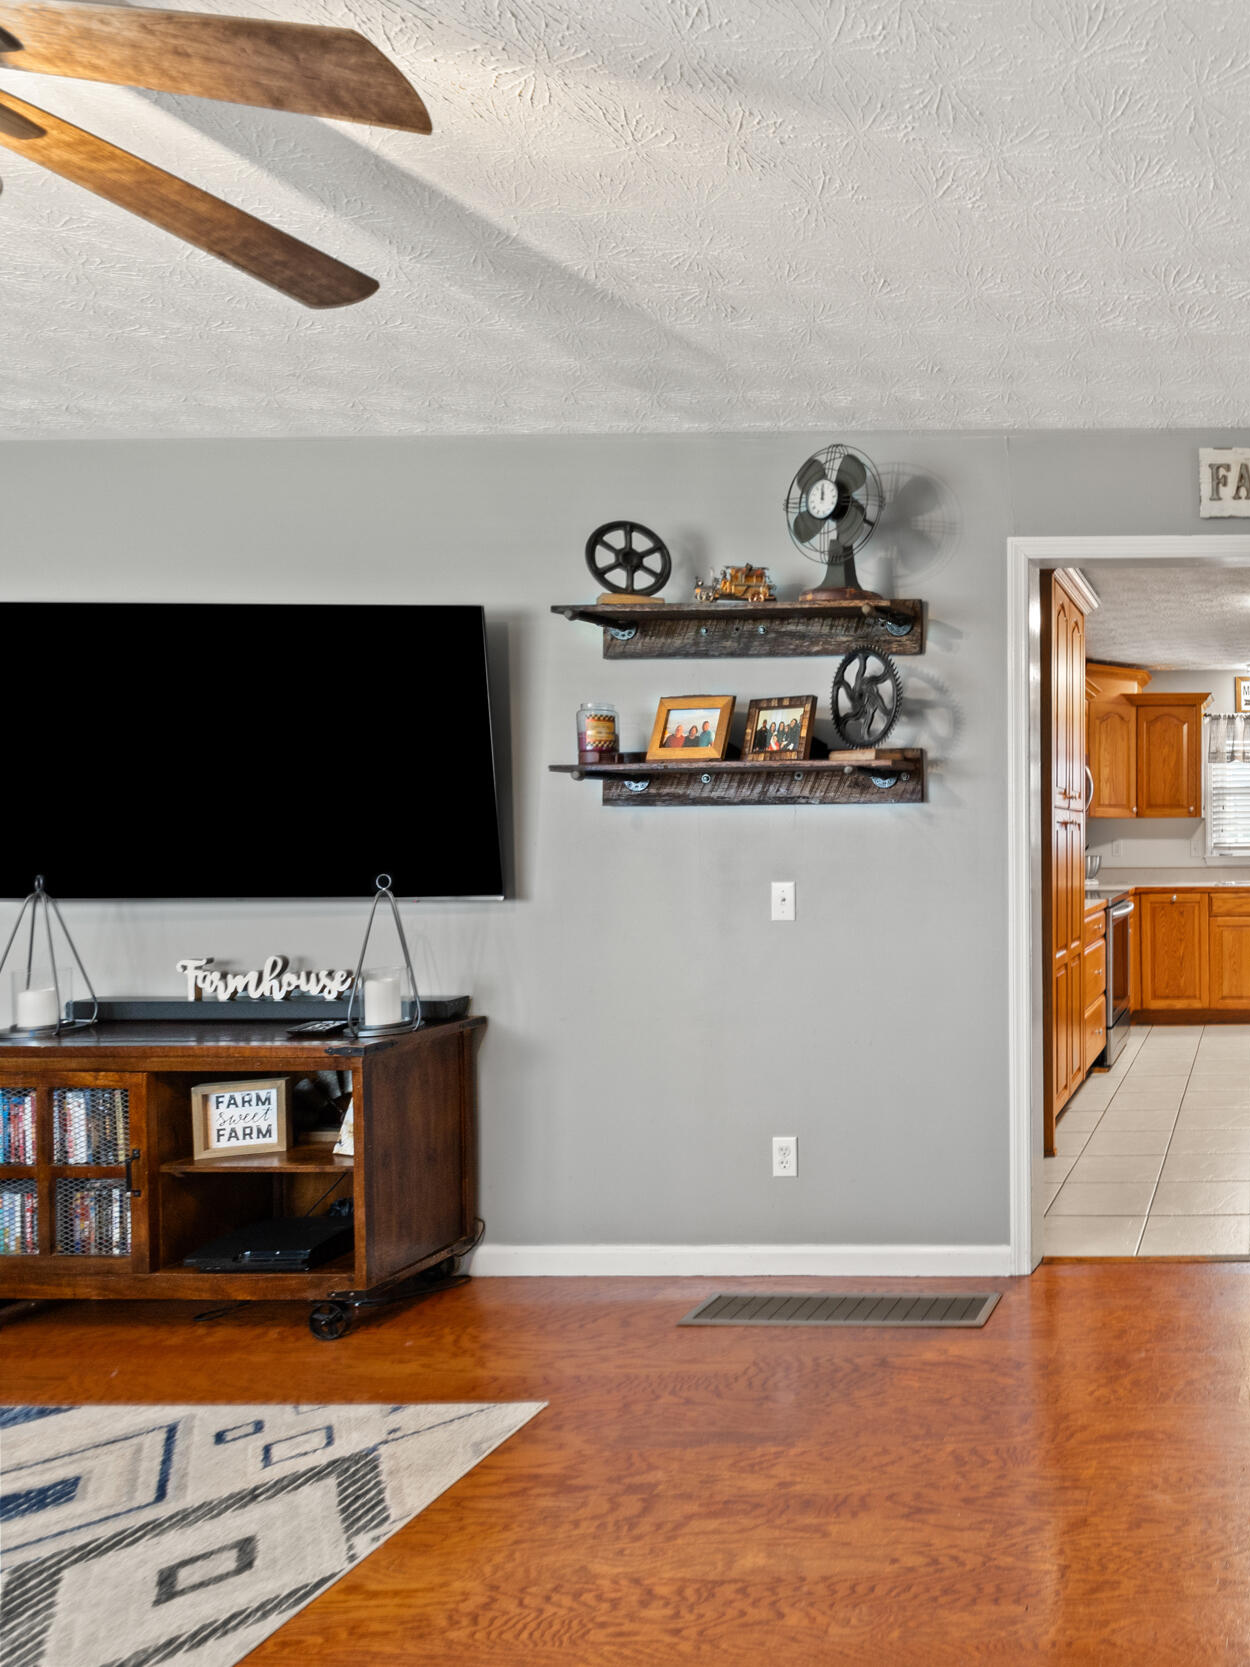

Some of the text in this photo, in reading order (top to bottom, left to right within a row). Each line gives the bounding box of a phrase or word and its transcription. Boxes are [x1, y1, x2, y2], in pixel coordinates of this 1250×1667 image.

[176, 955, 353, 1001] Farmhouse
[215, 1091, 272, 1110] FARM
[216, 1124, 272, 1143] FARM
